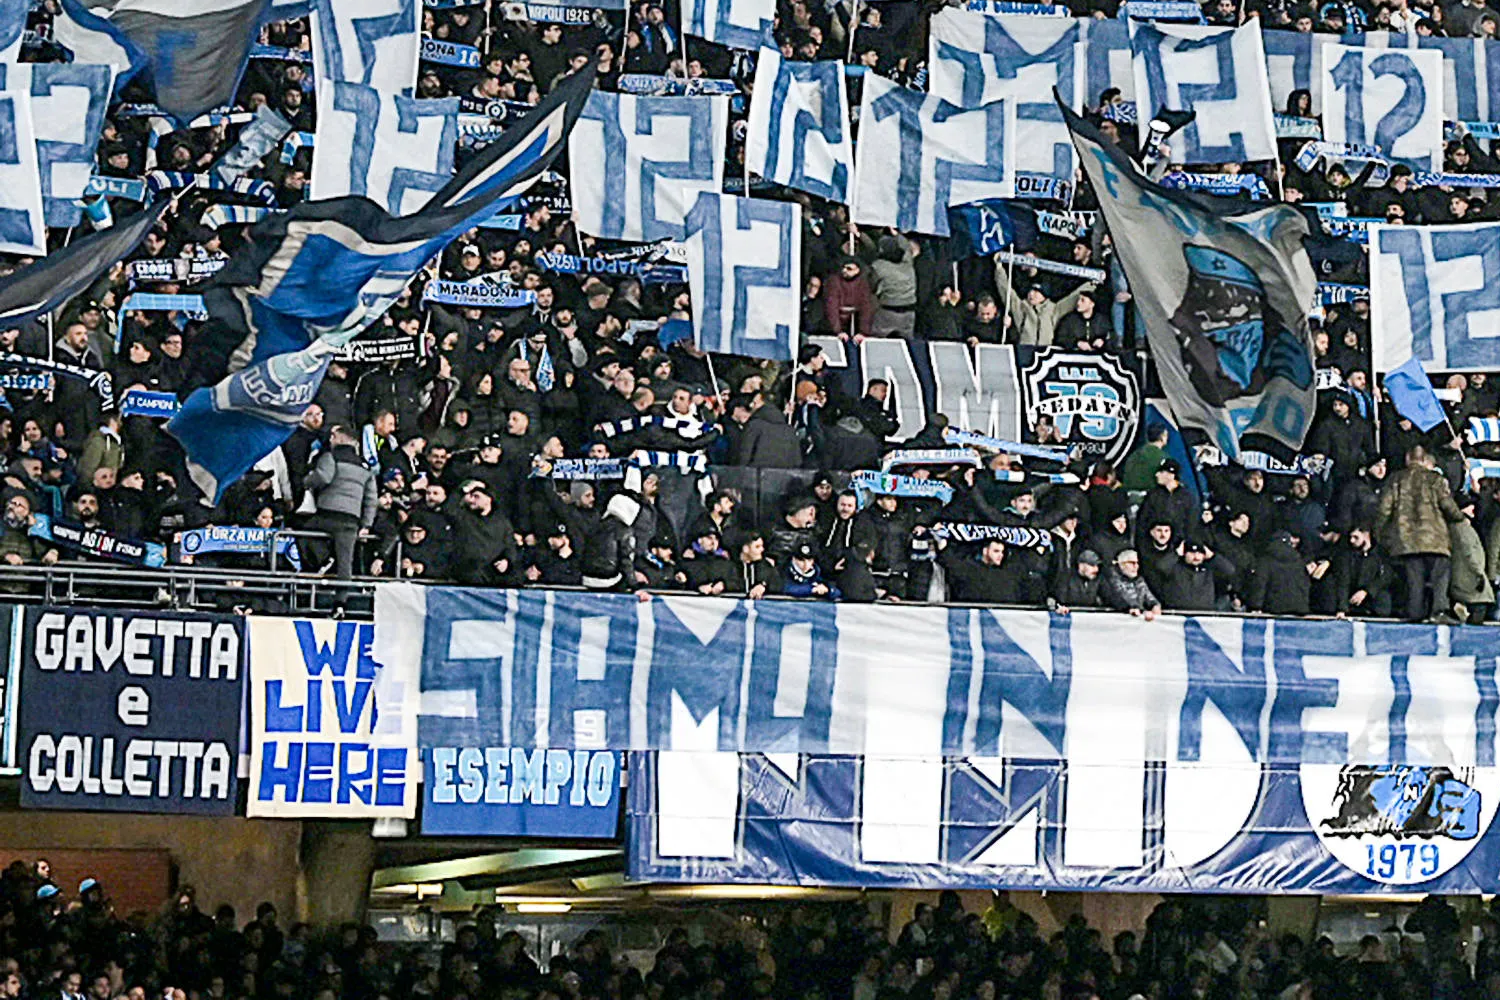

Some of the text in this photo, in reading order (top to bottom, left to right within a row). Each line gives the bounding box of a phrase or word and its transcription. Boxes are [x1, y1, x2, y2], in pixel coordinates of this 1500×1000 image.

[1329, 51, 1433, 166] 12
[93, 178, 129, 195] OLI
[581, 91, 714, 241] 12
[1016, 177, 1050, 193] OLI
[438, 282, 520, 298] MARADONA
[684, 191, 791, 361] 12
[204, 529, 245, 542] FORZA
[35, 613, 240, 681] GAVETTA
[417, 588, 836, 754] SIAMO
[943, 607, 1072, 758] IN
[116, 685, 149, 726] e
[264, 680, 392, 734] LIV
[28, 734, 231, 800] COLLETTA
[257, 741, 409, 807] HERE
[432, 748, 615, 807] ESEMPIO
[1365, 844, 1440, 879] 1979
